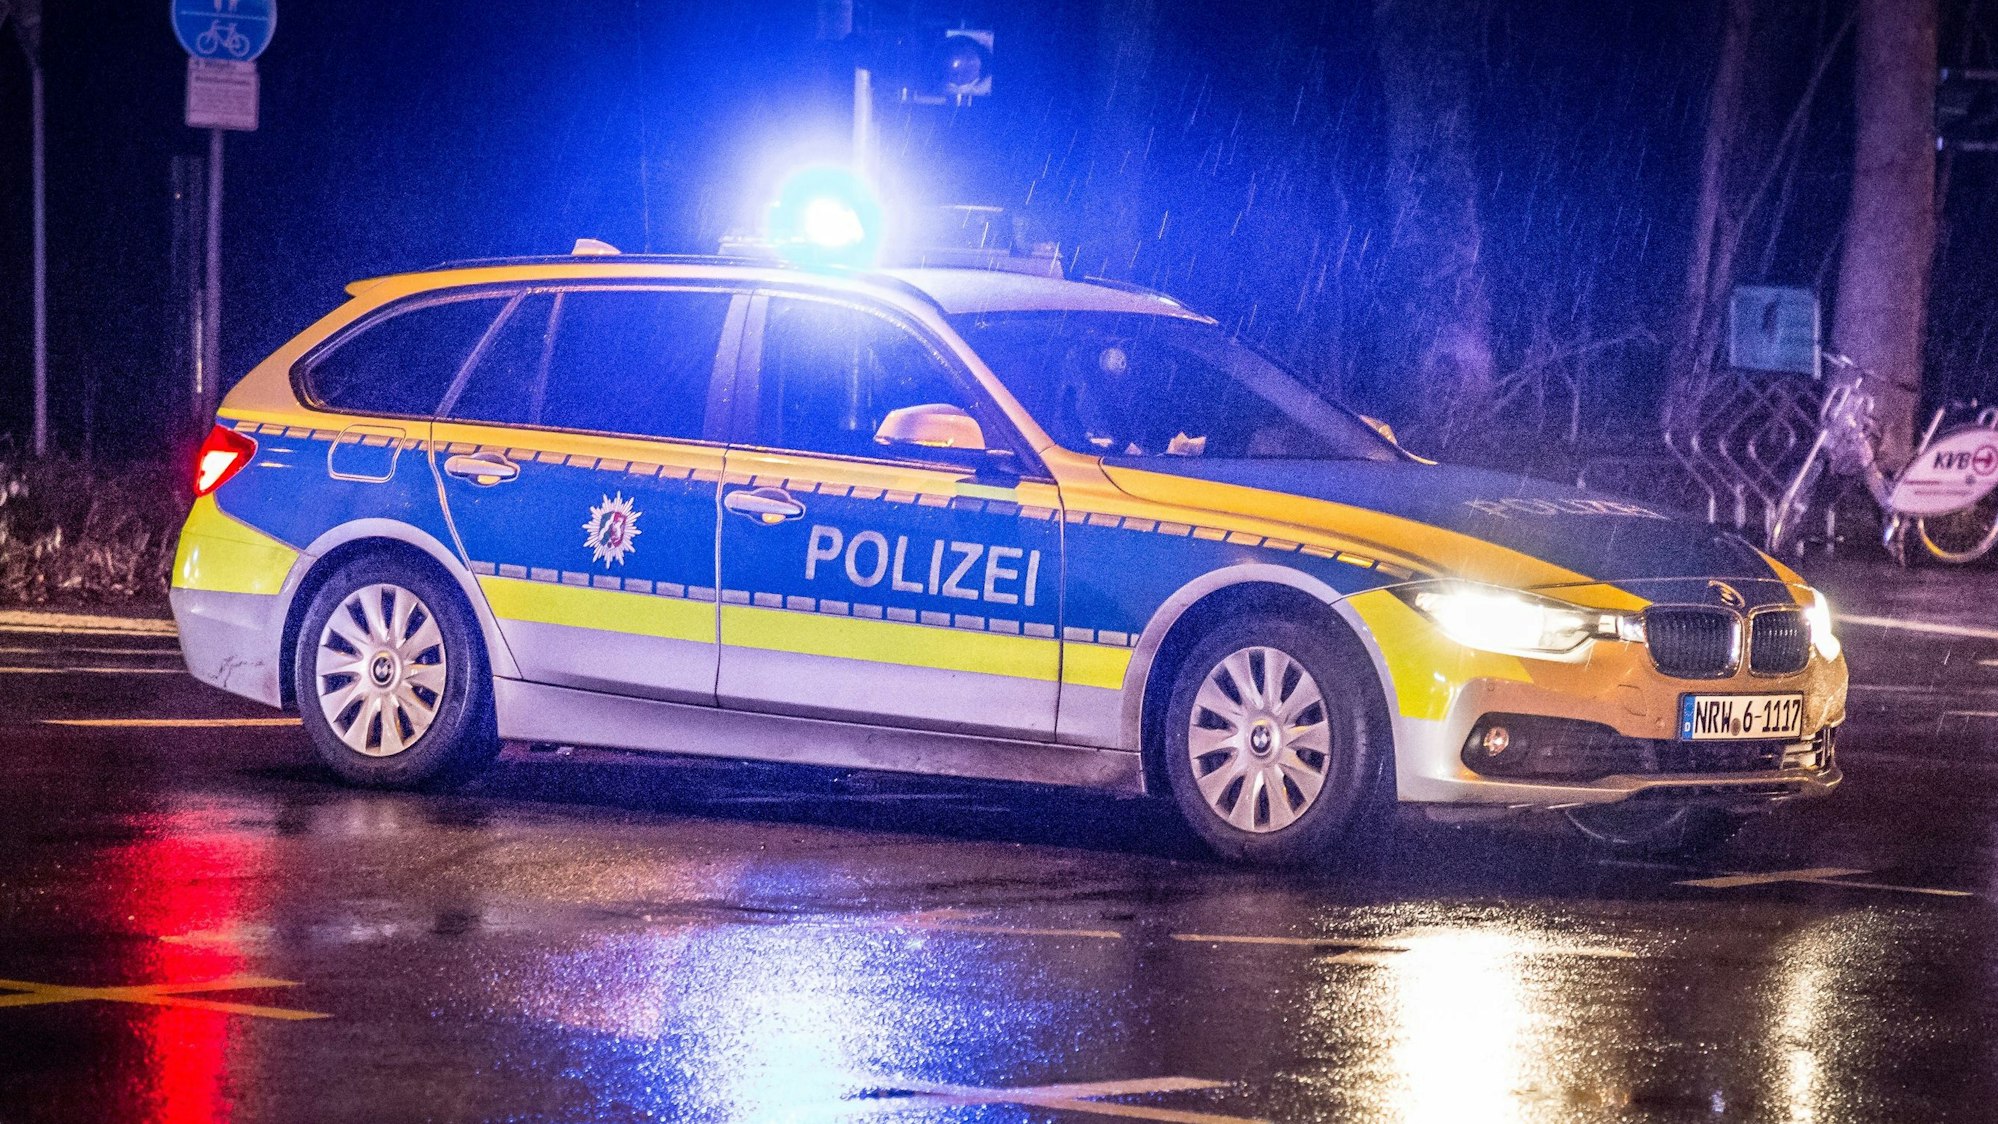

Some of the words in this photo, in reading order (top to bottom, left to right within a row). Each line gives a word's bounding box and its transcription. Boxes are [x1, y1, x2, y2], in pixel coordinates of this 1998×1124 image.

[1933, 452, 1971, 470] KVB
[805, 525, 1040, 606] POLIZEI
[1684, 722, 1690, 732] D
[1694, 701, 1733, 734] NRW
[1743, 699, 1800, 733] 6-1117
